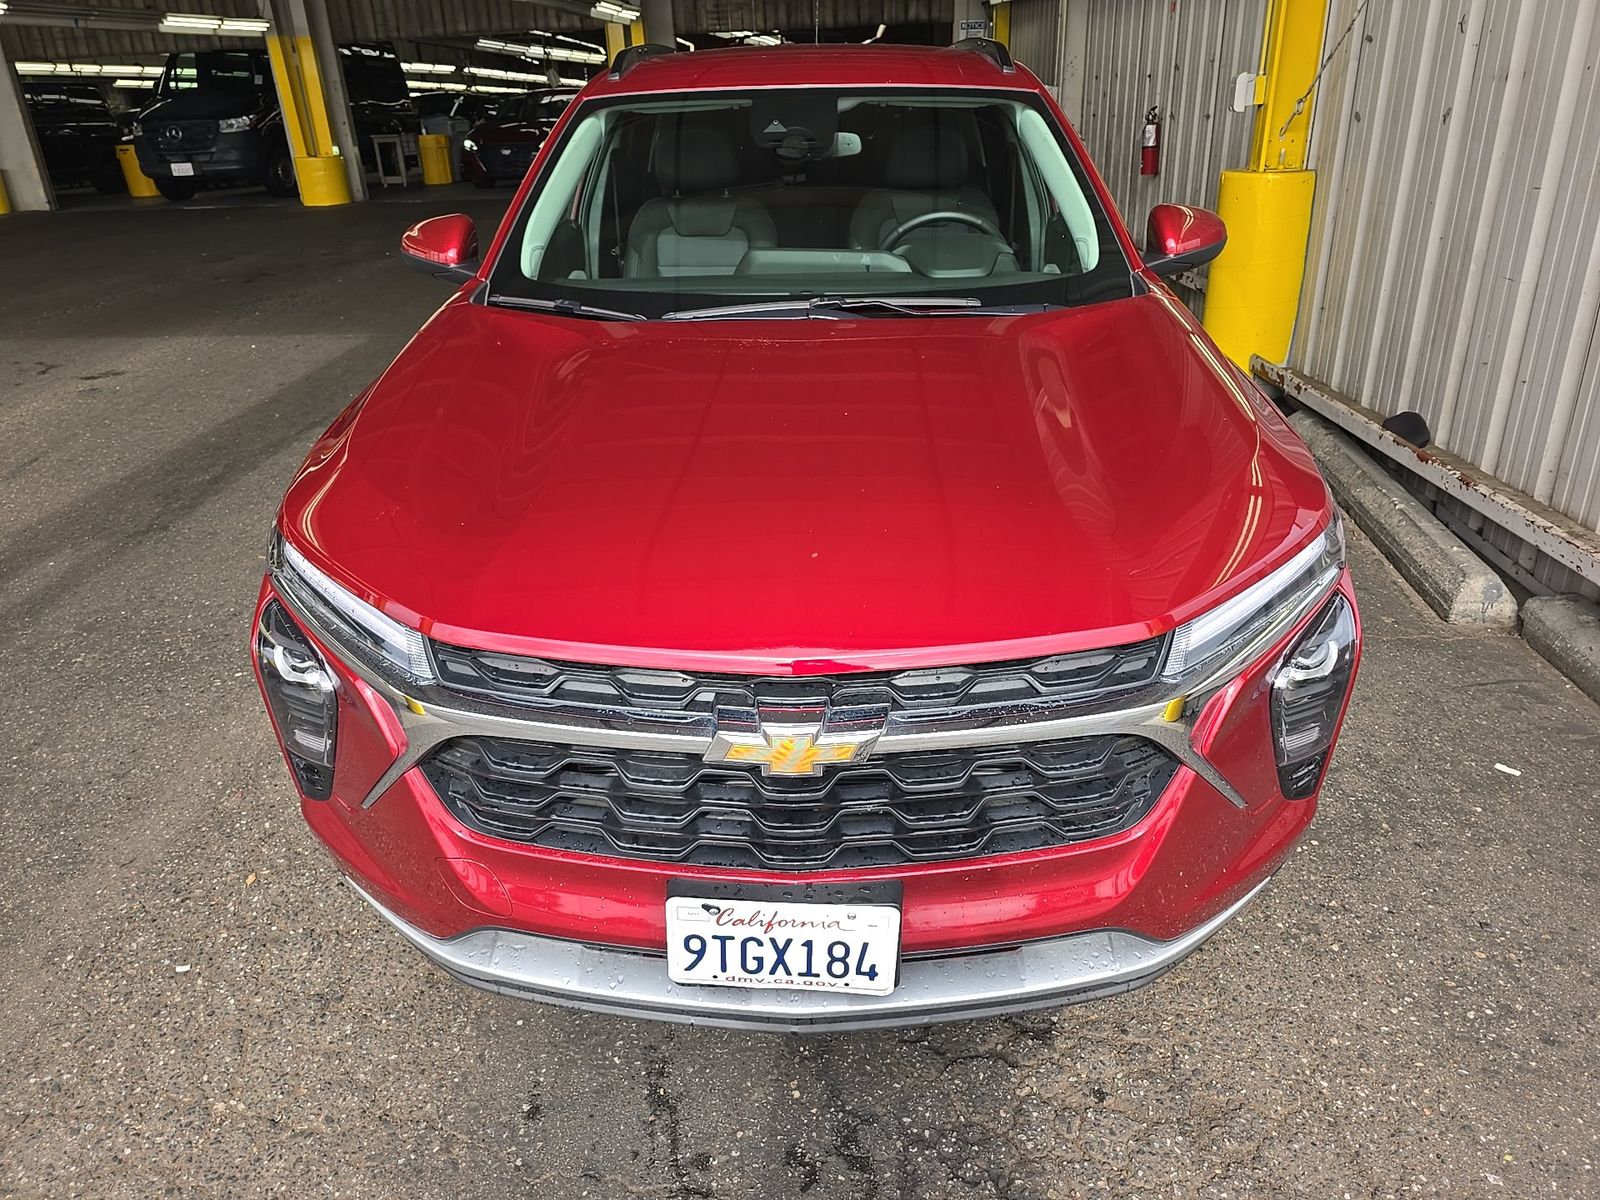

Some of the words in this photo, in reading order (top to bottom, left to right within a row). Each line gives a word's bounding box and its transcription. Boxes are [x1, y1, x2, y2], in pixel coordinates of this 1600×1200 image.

[716, 907, 856, 934] California
[684, 934, 879, 981] 9TGX184
[725, 975, 838, 988] dmv.ca.gov
